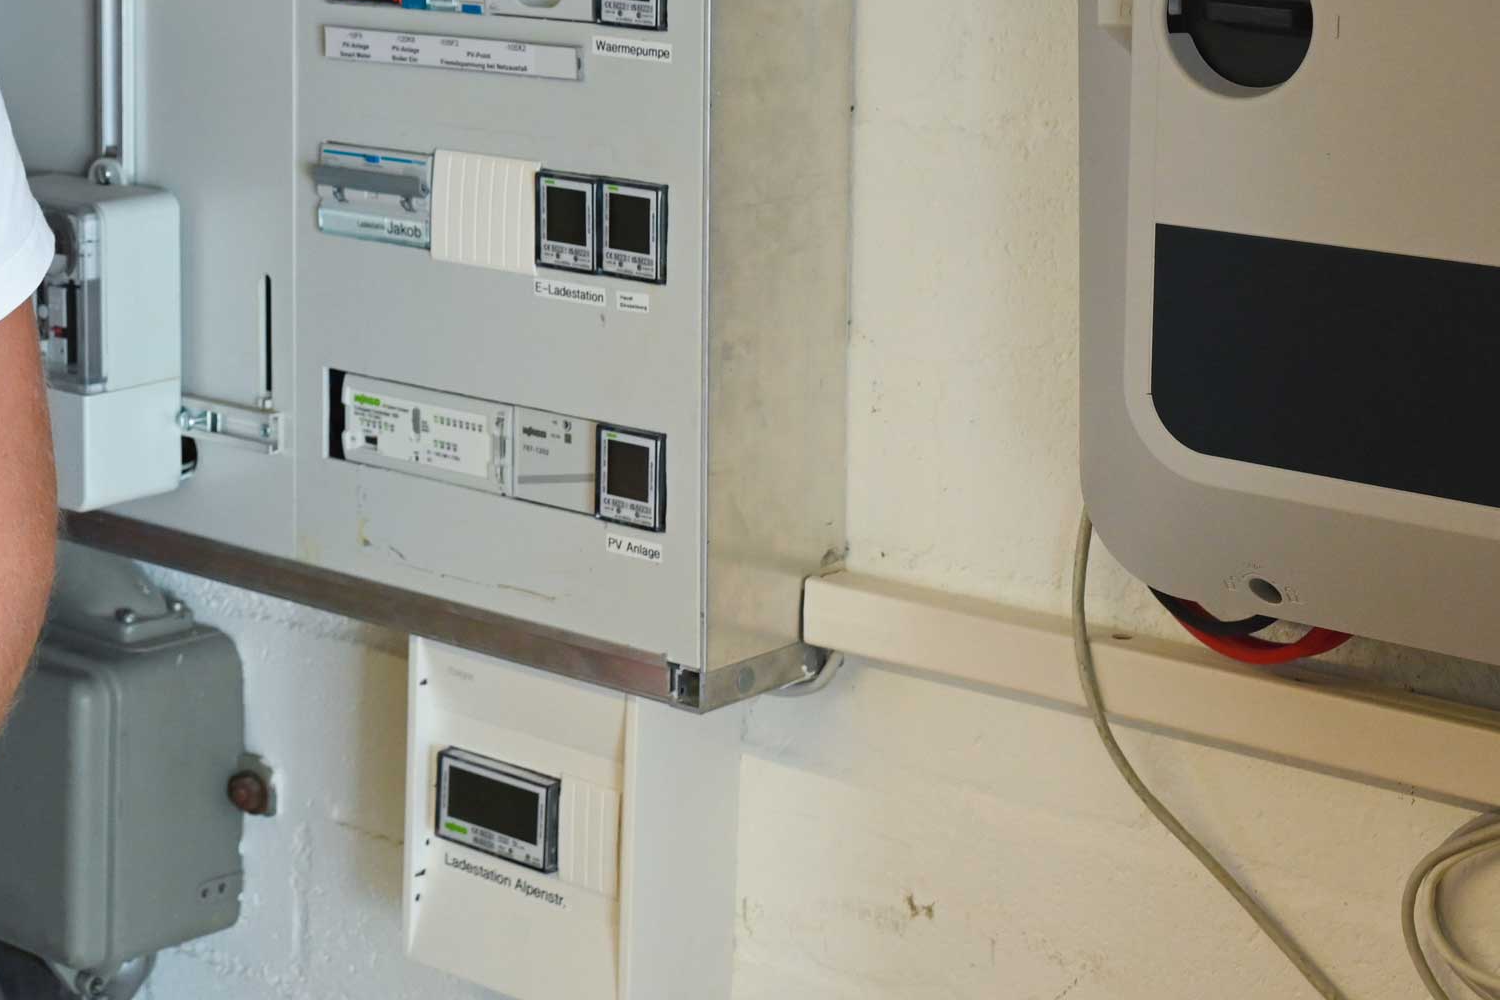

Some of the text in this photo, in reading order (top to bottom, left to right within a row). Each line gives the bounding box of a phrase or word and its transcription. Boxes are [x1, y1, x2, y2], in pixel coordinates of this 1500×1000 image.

[595, 40, 670, 60] Waermepumpe
[387, 221, 422, 239] Jakob
[535, 281, 604, 303] E-Ladestation
[608, 537, 661, 559] PV Anlage
[444, 853, 511, 889] Ladestation
